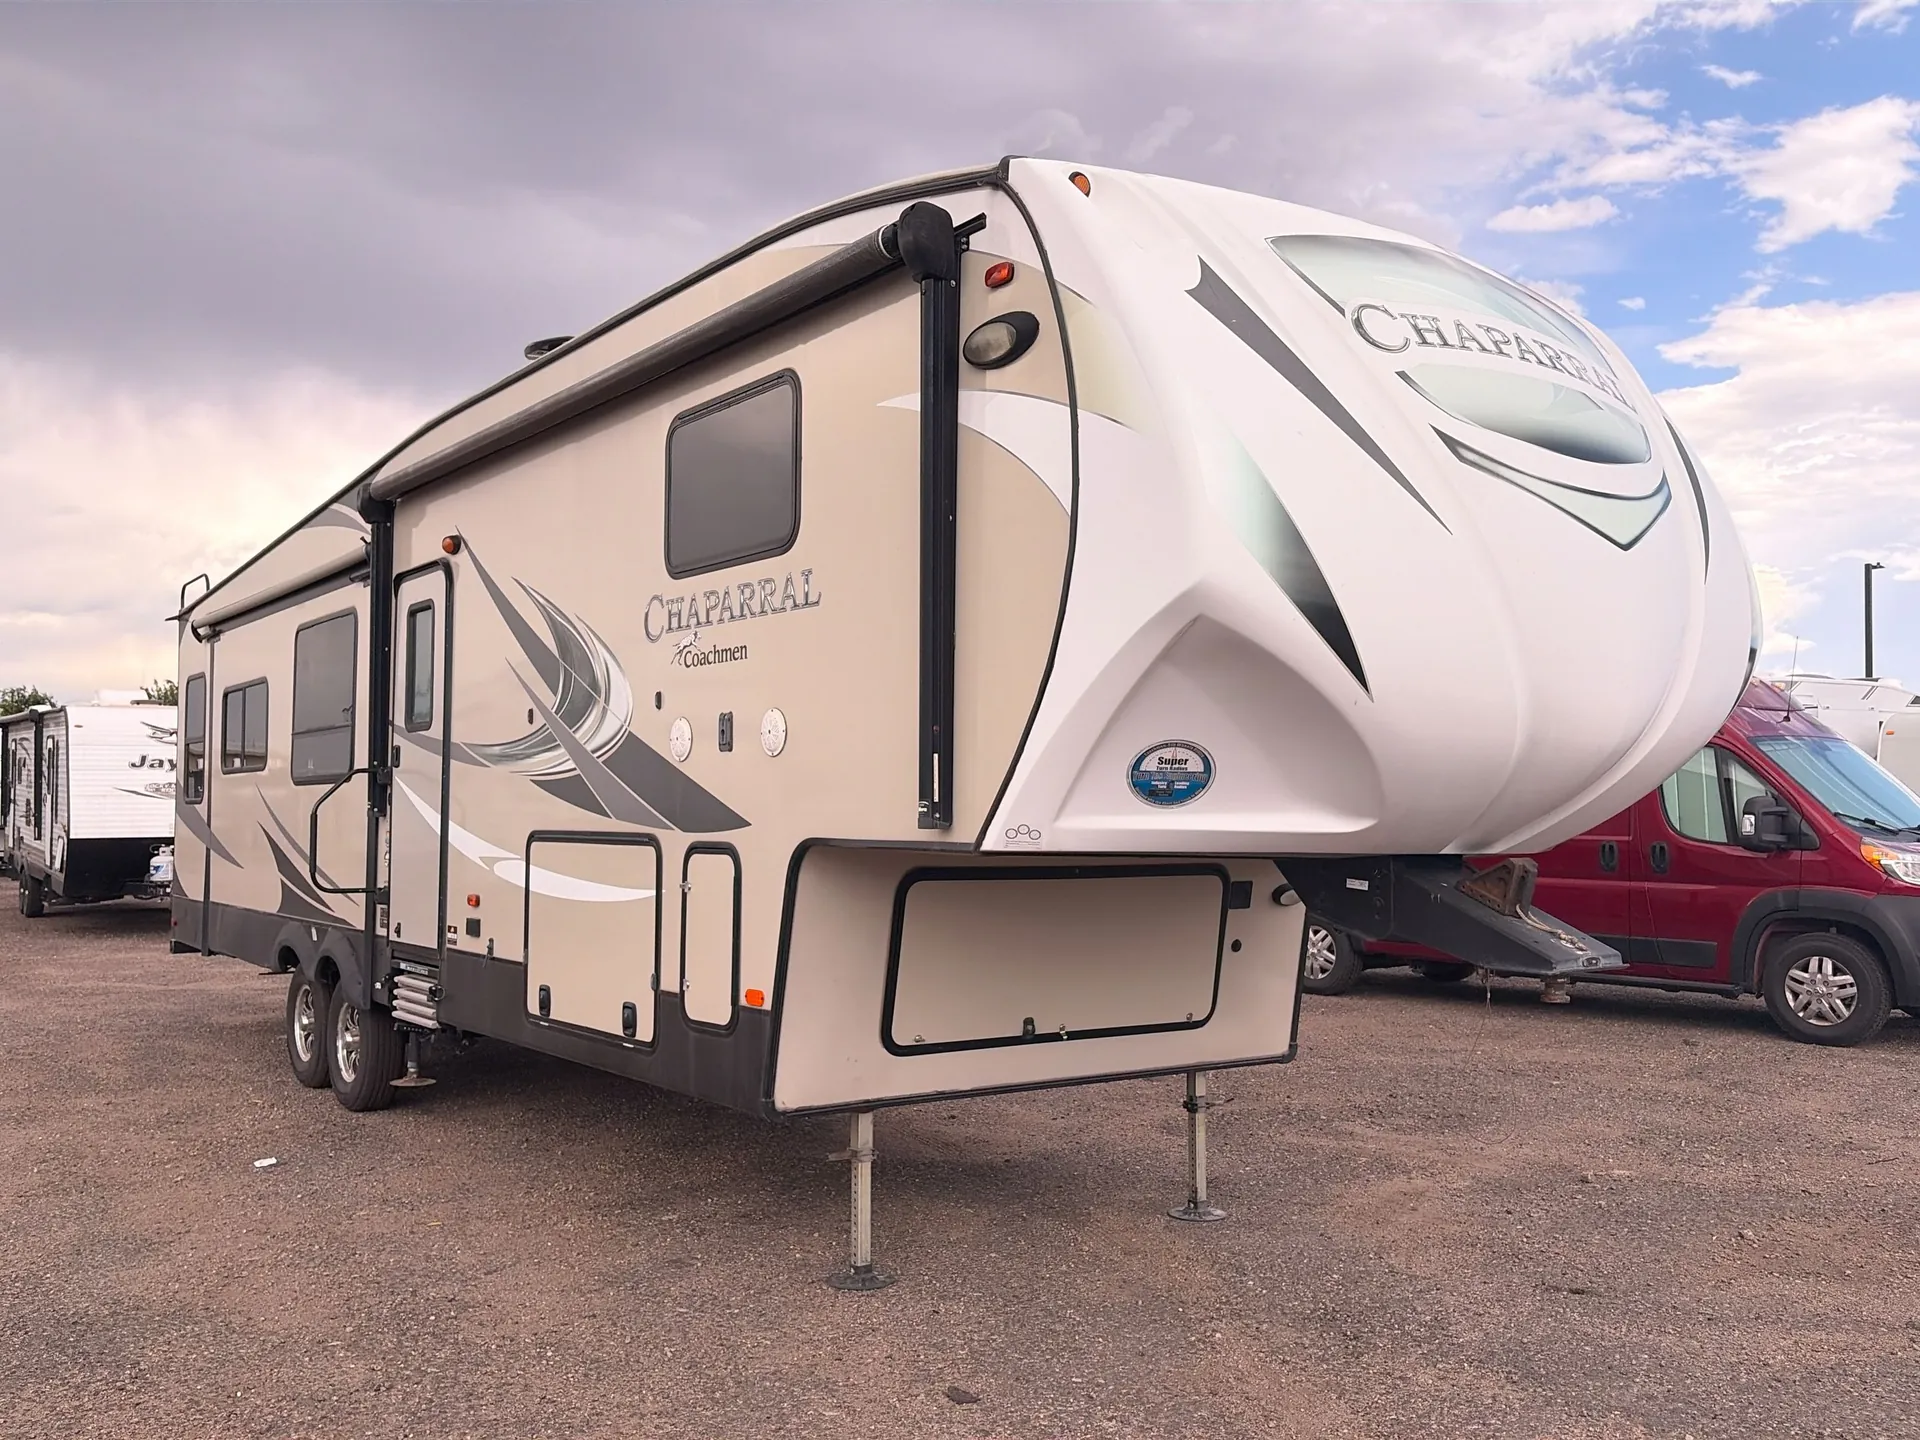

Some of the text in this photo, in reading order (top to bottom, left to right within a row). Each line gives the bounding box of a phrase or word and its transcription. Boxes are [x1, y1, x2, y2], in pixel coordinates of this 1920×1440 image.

[1350, 302, 1638, 415] CHAPARRAL
[643, 567, 822, 644] CHAPARRAL
[683, 643, 748, 669] Coachmen
[129, 754, 177, 773] Jay
[1157, 756, 1189, 766] Super
